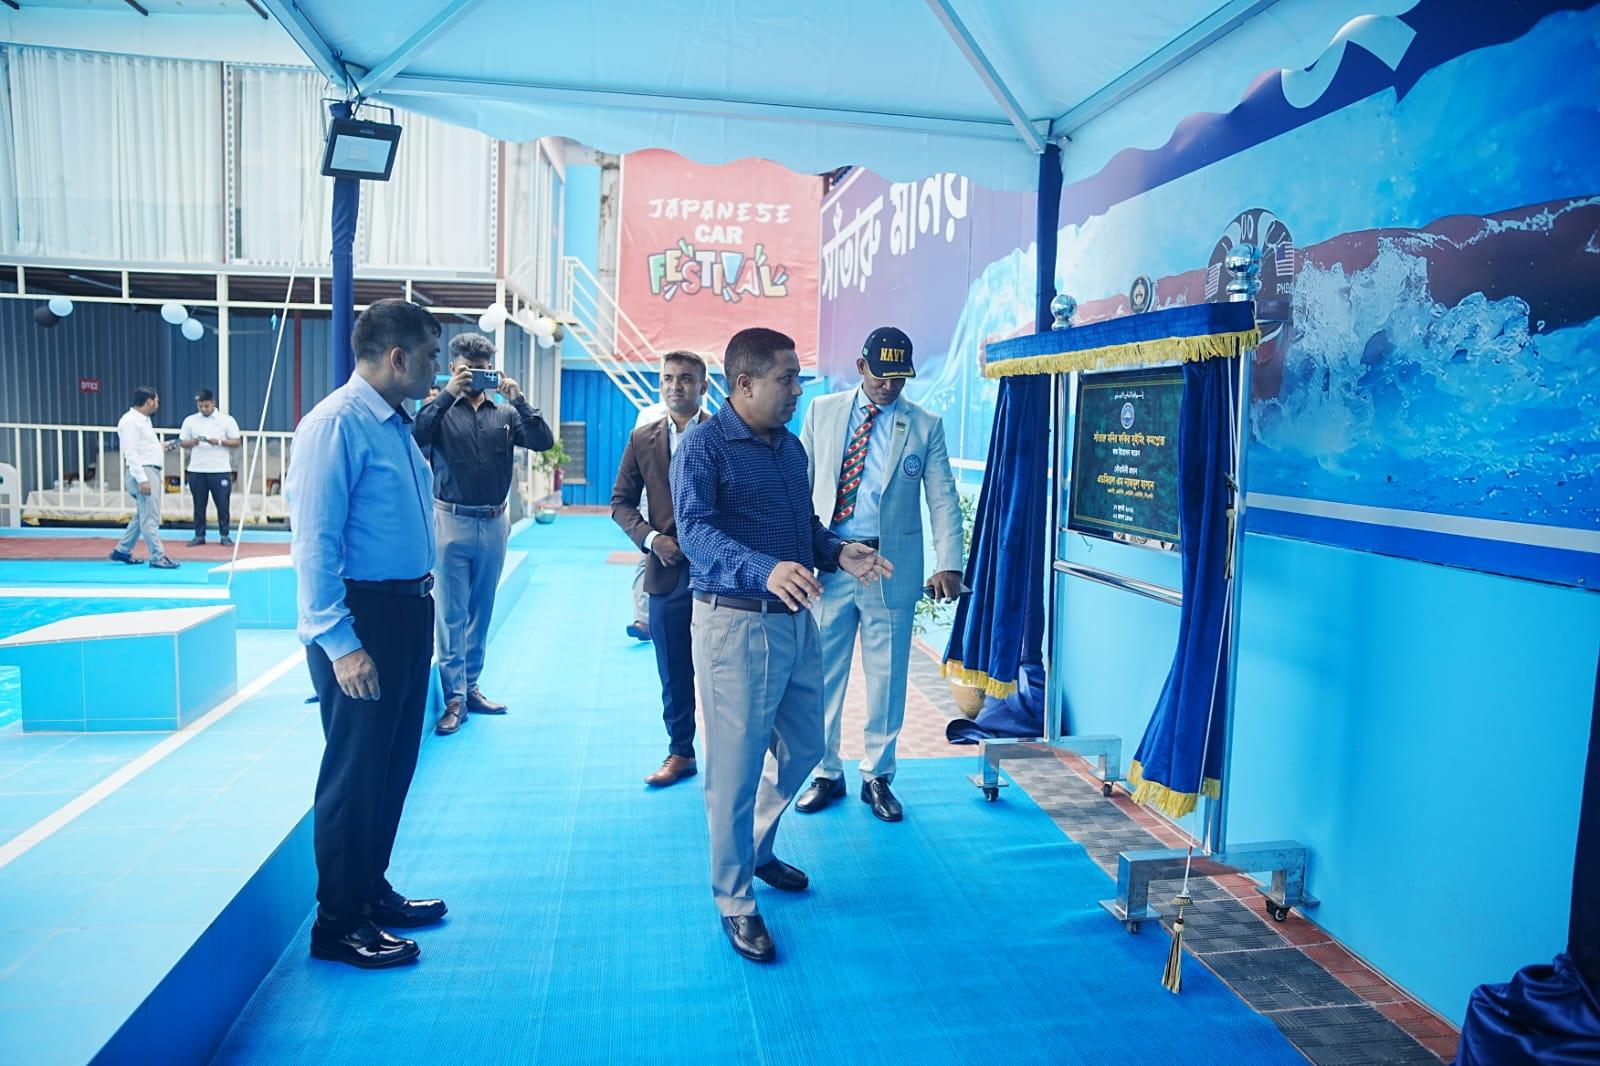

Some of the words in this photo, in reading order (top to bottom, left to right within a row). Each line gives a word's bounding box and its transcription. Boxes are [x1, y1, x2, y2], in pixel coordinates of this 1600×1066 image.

[648, 198, 791, 224] JAPANESE
[694, 224, 743, 245] CAR
[822, 194, 884, 301] সাঁতারু
[647, 247, 789, 298] FESTIVAL
[880, 347, 905, 363] NAVY
